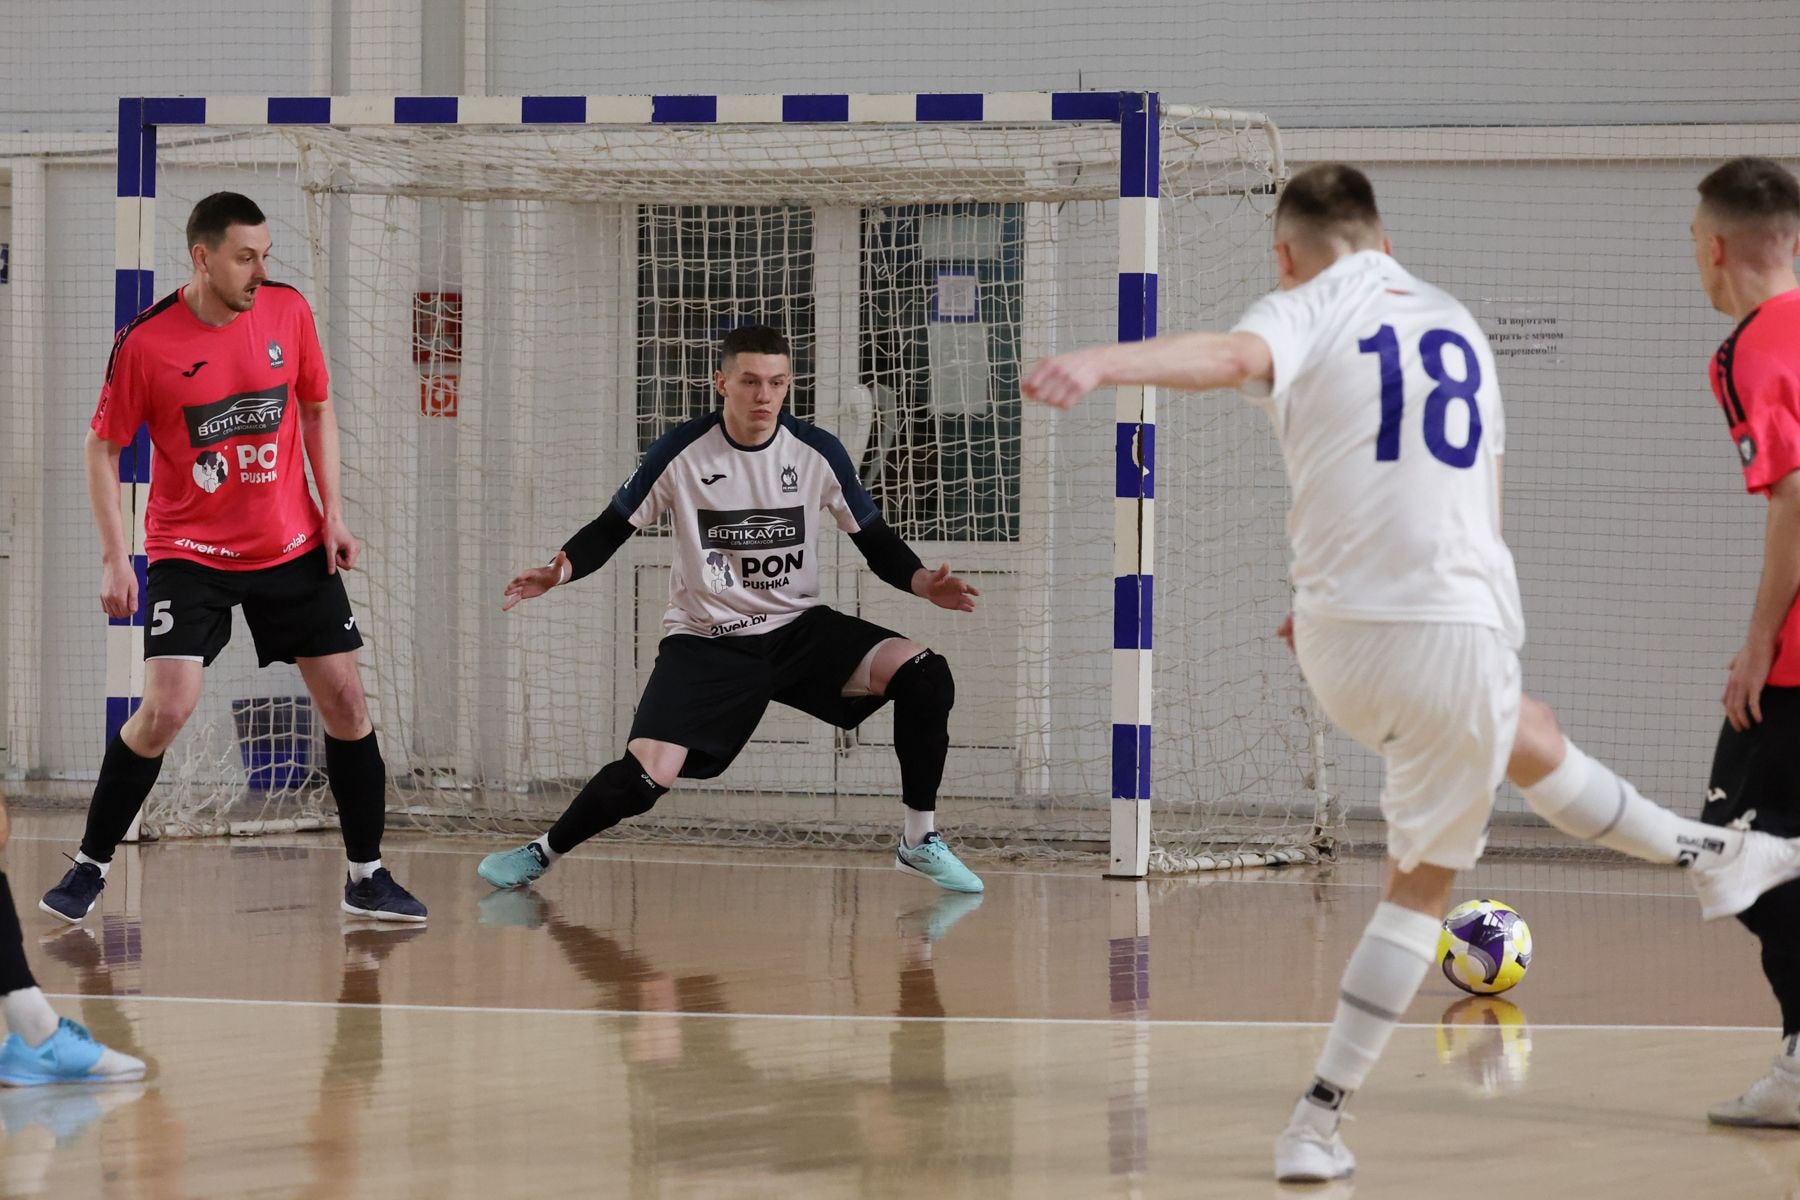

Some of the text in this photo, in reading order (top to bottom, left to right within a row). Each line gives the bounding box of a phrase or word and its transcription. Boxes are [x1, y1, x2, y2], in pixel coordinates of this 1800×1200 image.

[1358, 323, 1483, 469] 18
[236, 436, 279, 470] PO
[240, 470, 278, 483] PUSHK
[707, 526, 796, 540] BUTIKAVTO
[741, 549, 804, 578] PON
[742, 576, 790, 590] PUSHKA
[151, 600, 174, 636] 5
